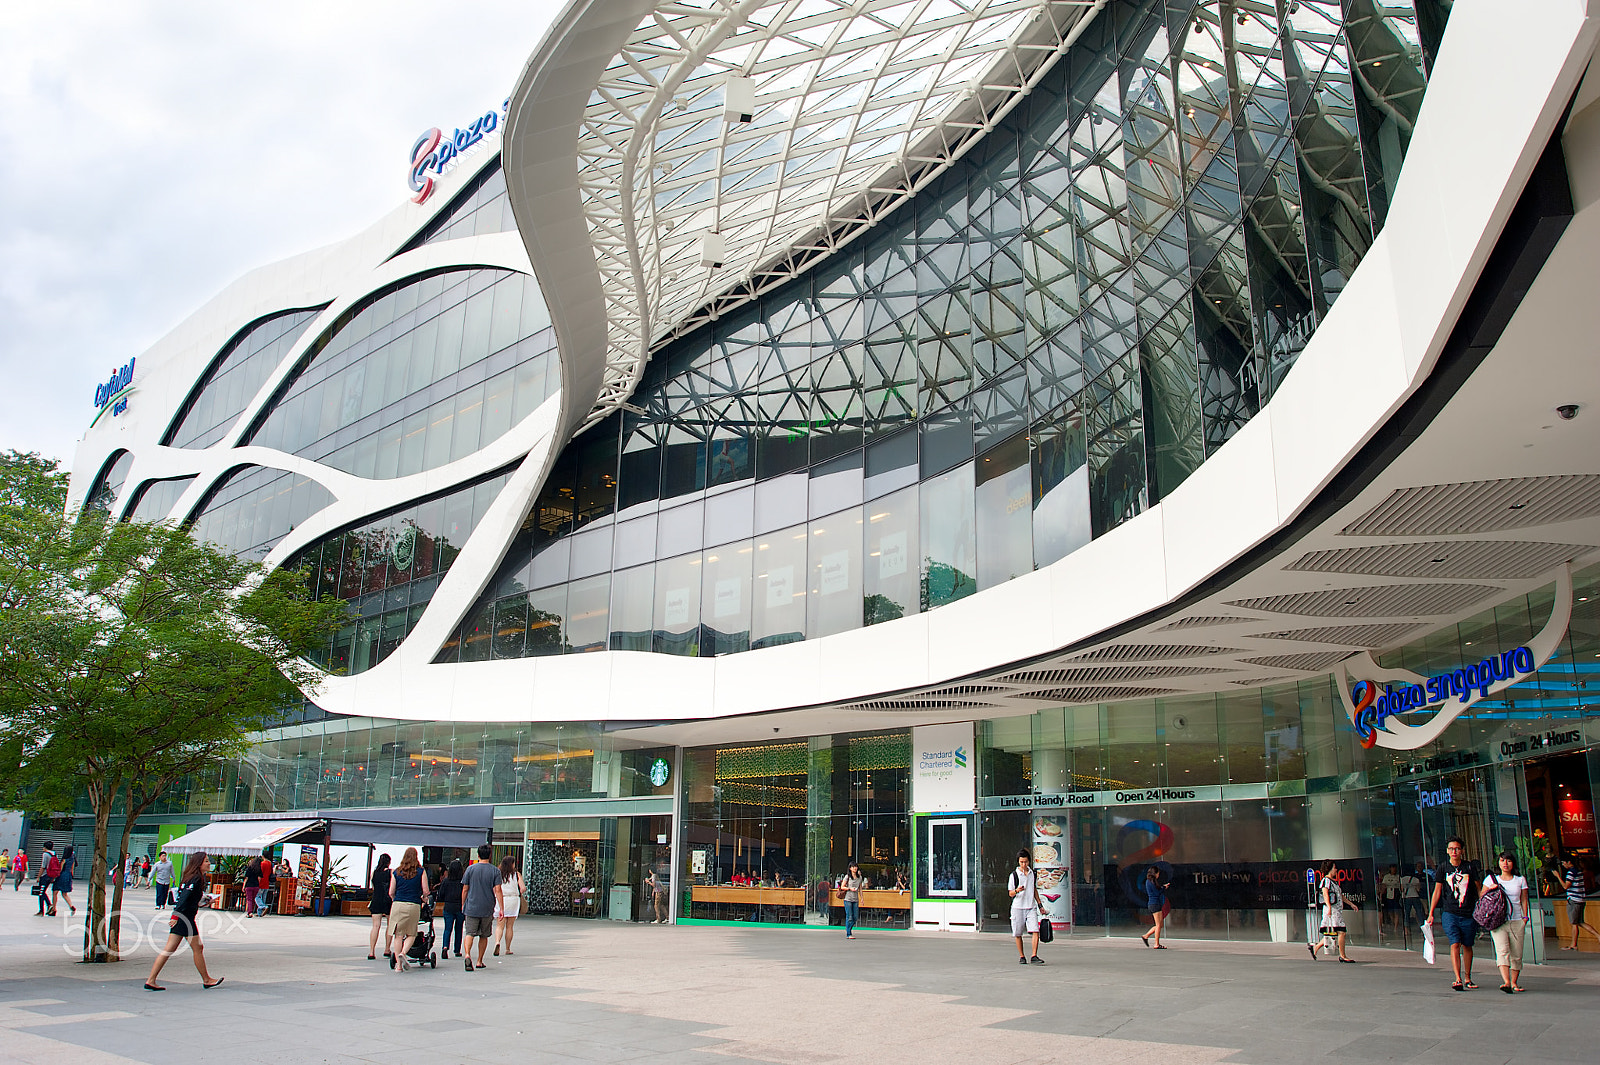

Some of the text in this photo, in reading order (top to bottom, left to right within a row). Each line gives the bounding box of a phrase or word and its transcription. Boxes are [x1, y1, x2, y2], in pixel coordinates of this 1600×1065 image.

[437, 110, 497, 174] plaza
[1377, 646, 1535, 728] plaza singapura
[1501, 730, 1581, 758] Open 24 Hours
[922, 751, 953, 760] Standard
[1458, 752, 1480, 765] Lane
[919, 760, 953, 769] Chartered
[940, 770, 953, 778] good
[1000, 793, 1095, 807] Link to Handy Road
[1115, 788, 1196, 803] Open 24 Hours
[1562, 811, 1593, 822] SALE
[1192, 871, 1217, 884] The
[1221, 870, 1252, 884] New
[1258, 867, 1299, 887] plaza
